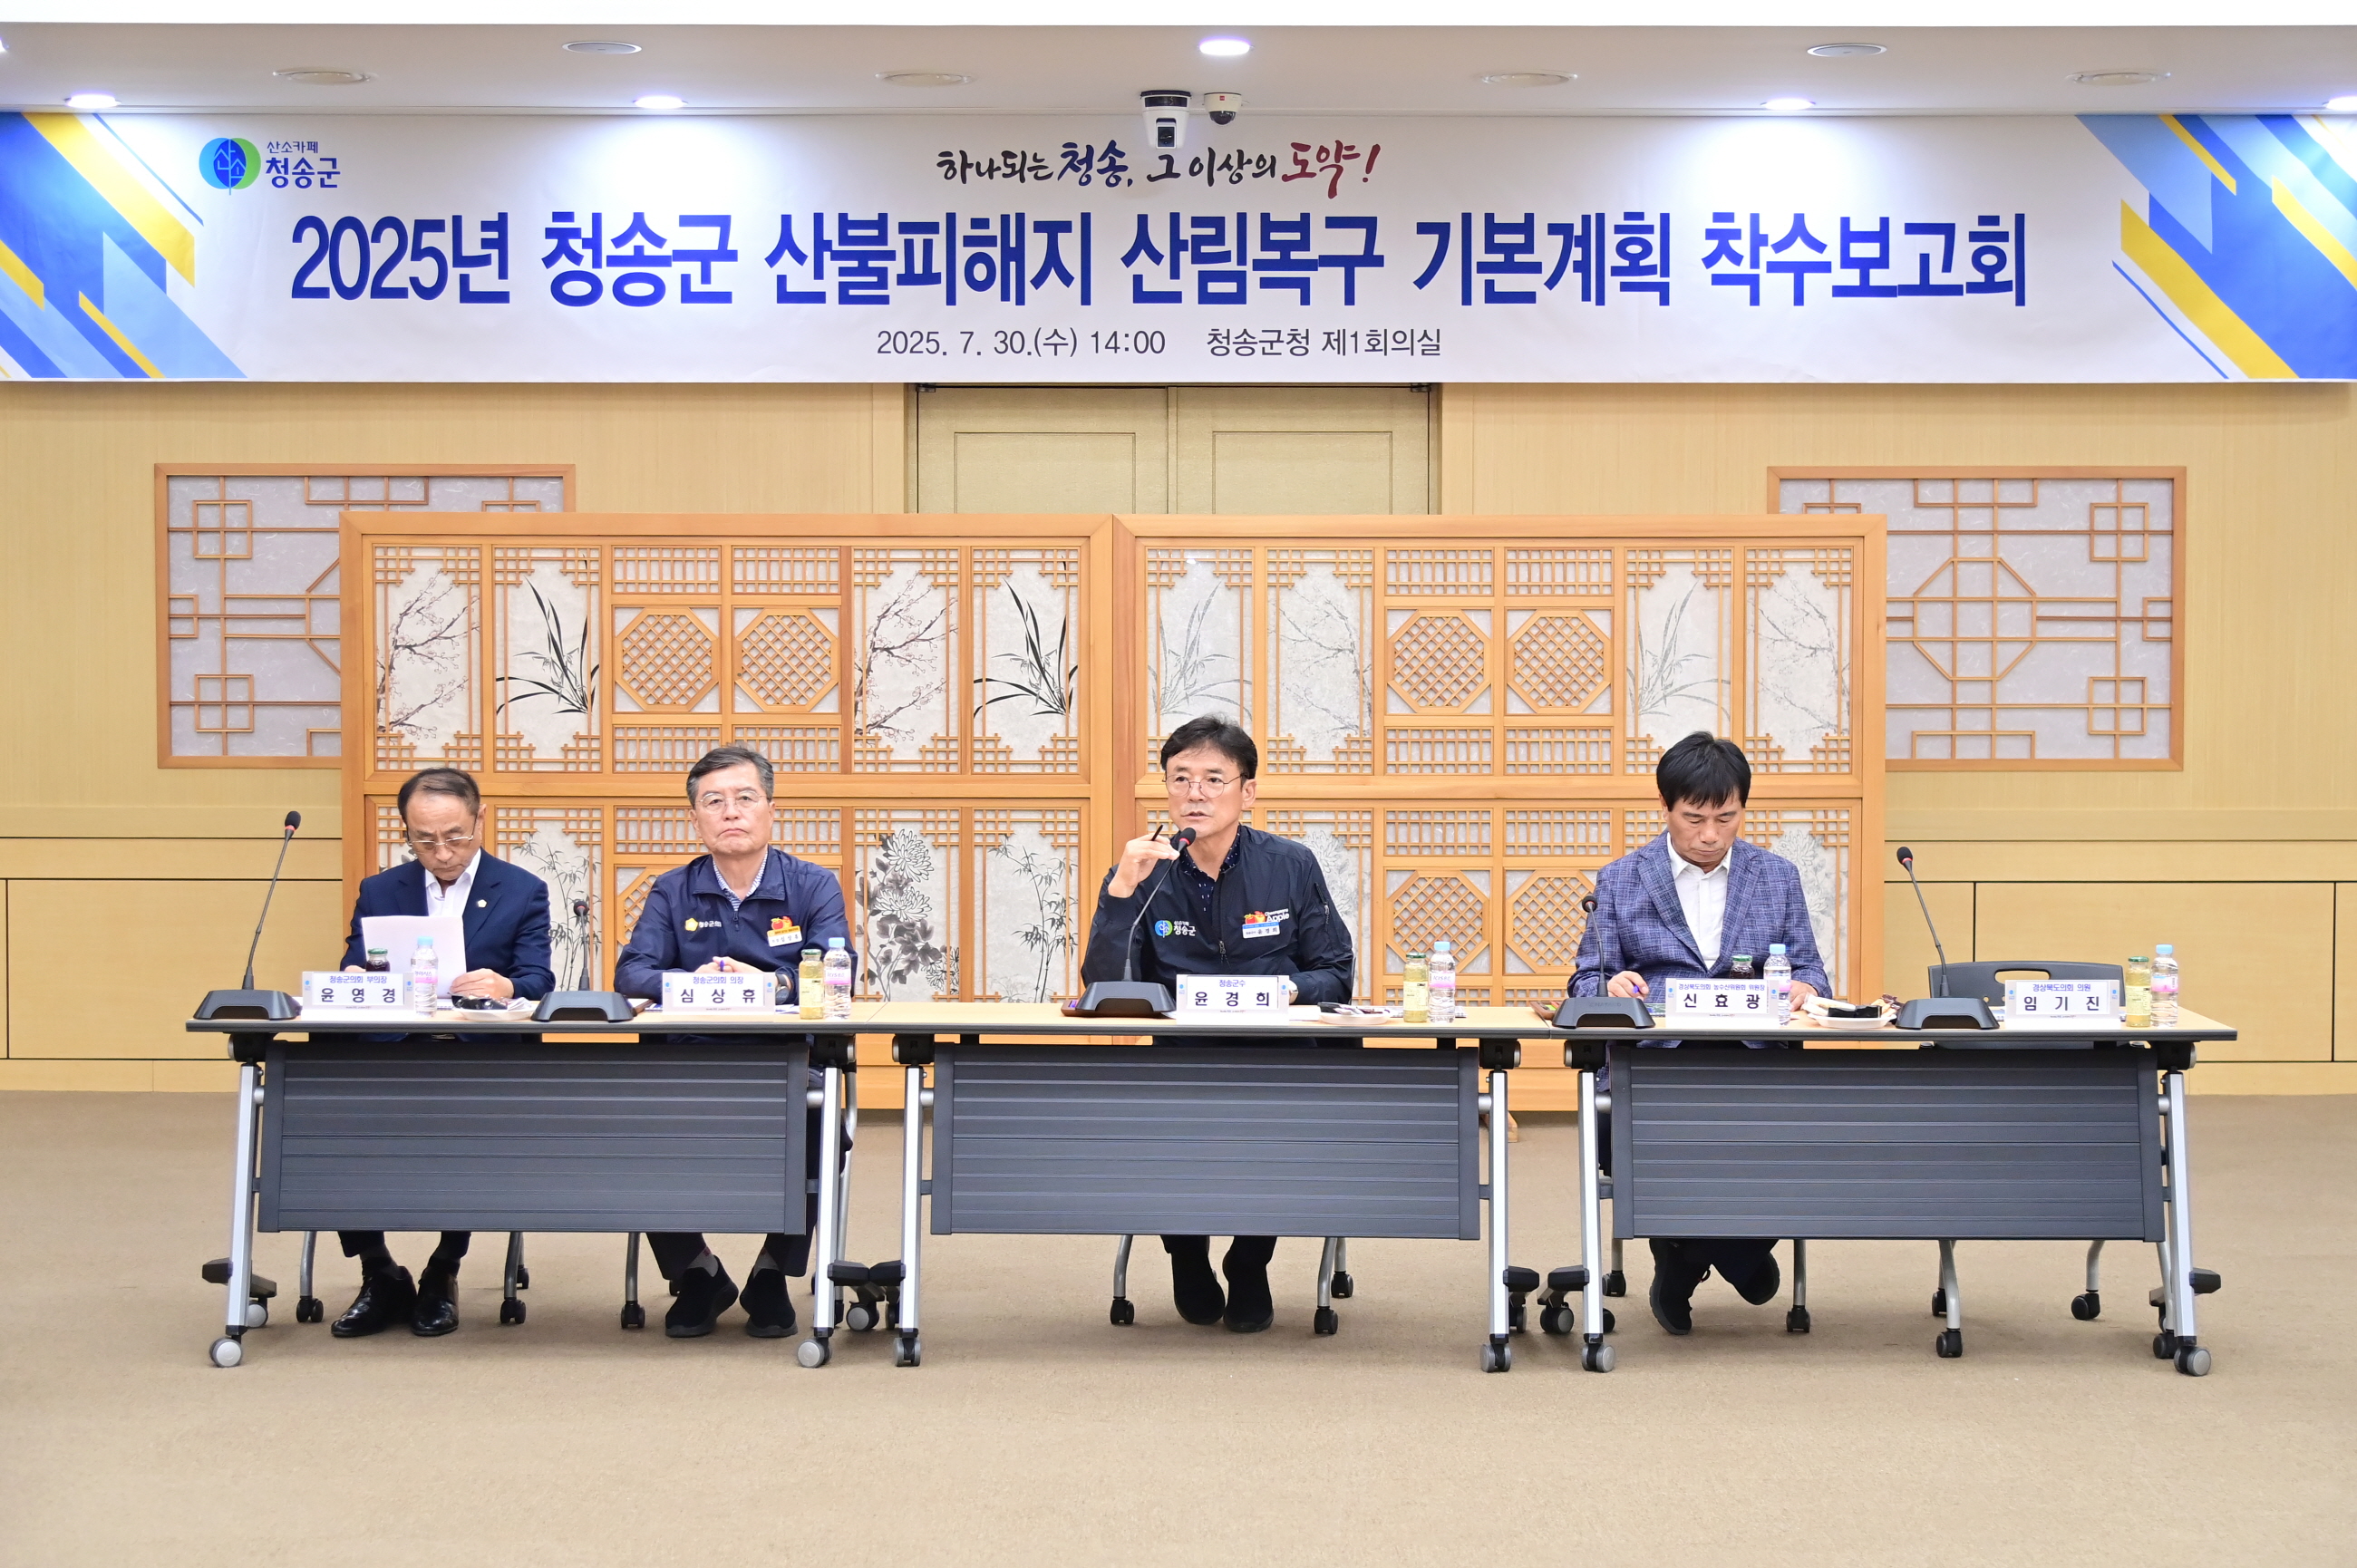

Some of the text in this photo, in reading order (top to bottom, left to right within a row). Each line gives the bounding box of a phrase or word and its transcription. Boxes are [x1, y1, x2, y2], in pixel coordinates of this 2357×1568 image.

[267, 140, 319, 154] 산소카페
[266, 157, 341, 189] 청송군
[936, 139, 1381, 199] 하나되는 청송, 그 이상의 도약!
[291, 211, 2026, 307] 2025년 청송군 산불피해지 산림복구 기본계획 착수보고회
[878, 327, 1440, 358] 2025. 7. 30.(수) 14:00 청송군청 제1회의실
[1174, 925, 1196, 936] 청송군
[329, 975, 388, 984] 청송군의회 부의장
[693, 976, 744, 984] 청송군의회 의장
[1218, 979, 1246, 988] 청송군수
[320, 987, 396, 1003] 윤 영 경
[1678, 983, 1712, 992] 경상북도의회
[2032, 983, 2091, 992] 경상북도의회 의원
[680, 988, 756, 1003] 심 상 휴
[1194, 991, 1270, 1008] 윤 경 희
[1683, 993, 1760, 1010] 신 효 광
[2023, 996, 2100, 1011] 임 기 진
